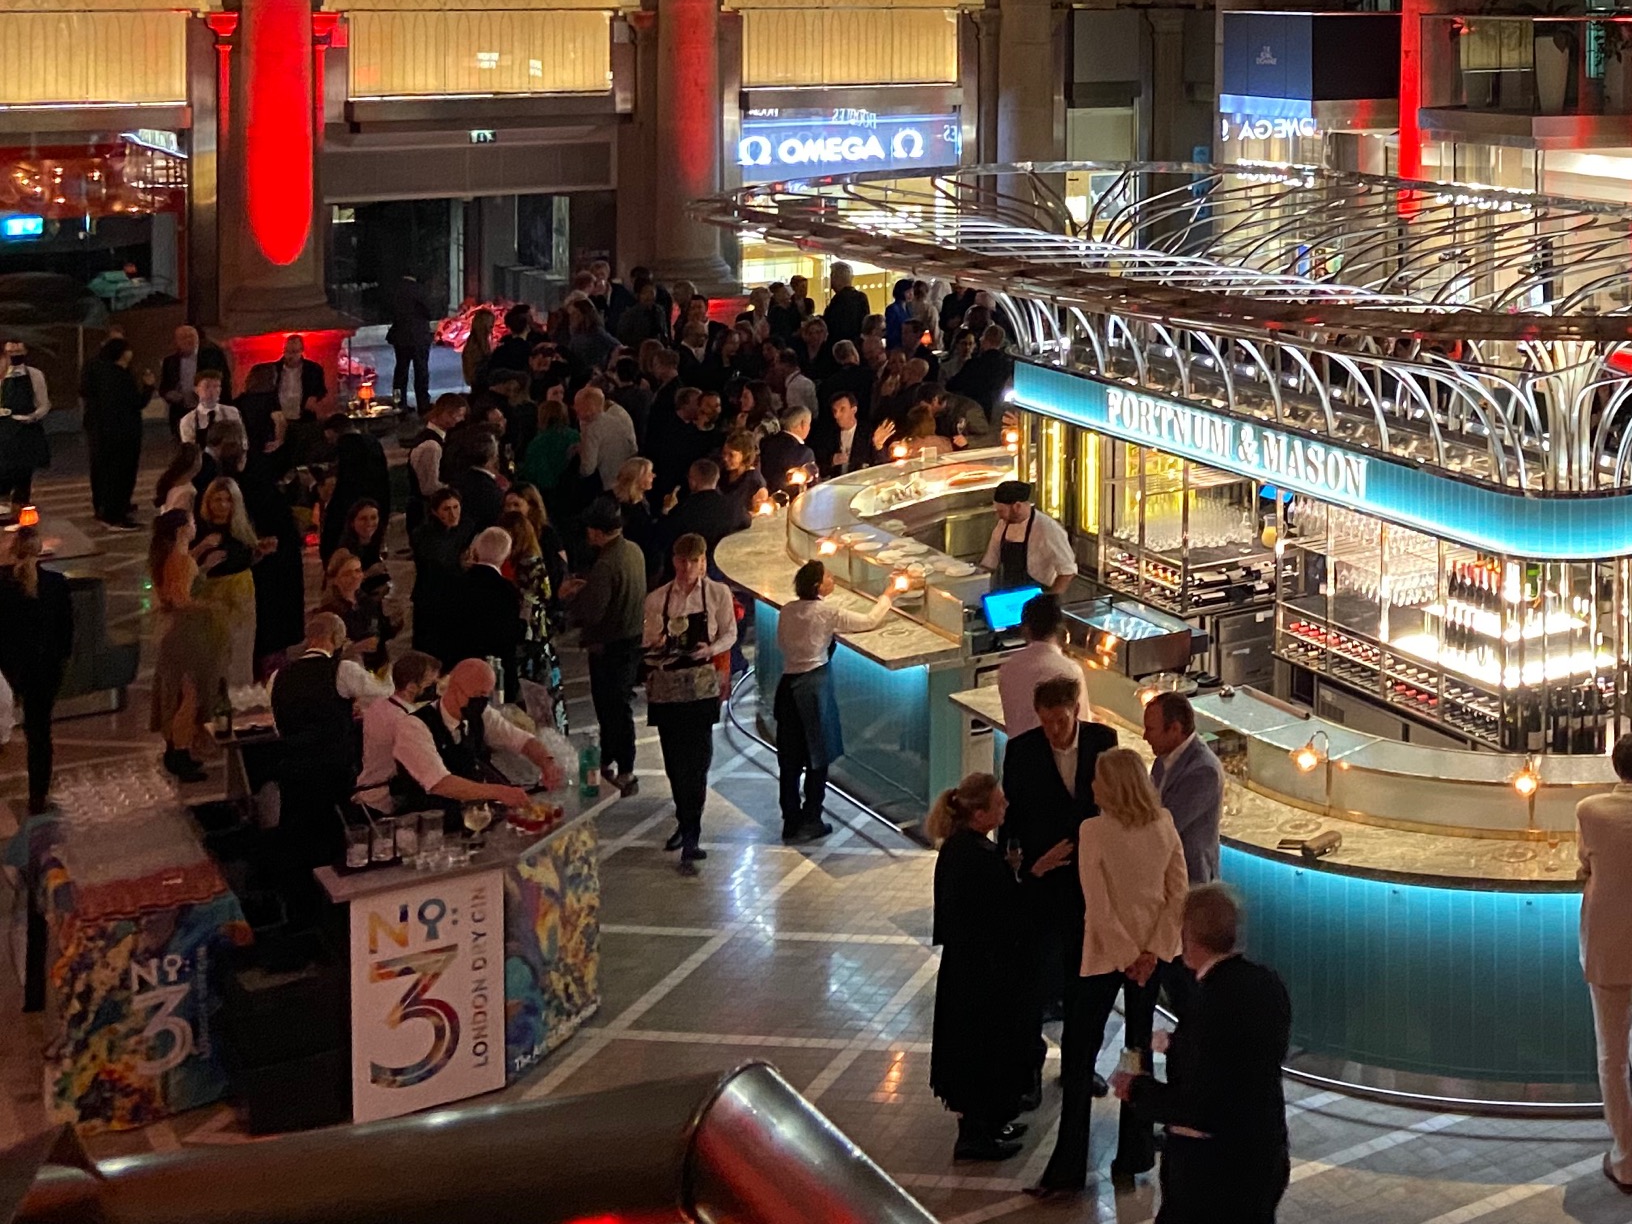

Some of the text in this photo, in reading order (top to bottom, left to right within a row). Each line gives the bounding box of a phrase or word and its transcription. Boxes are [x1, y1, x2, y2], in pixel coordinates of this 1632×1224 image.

[778, 135, 885, 164] OMEGA
[1106, 389, 1369, 499] FORTNUM & MASON
[471, 930, 488, 972] DRY
[132, 982, 194, 1077] 3
[368, 943, 461, 1089] 3
[471, 980, 490, 1068] LONDON
